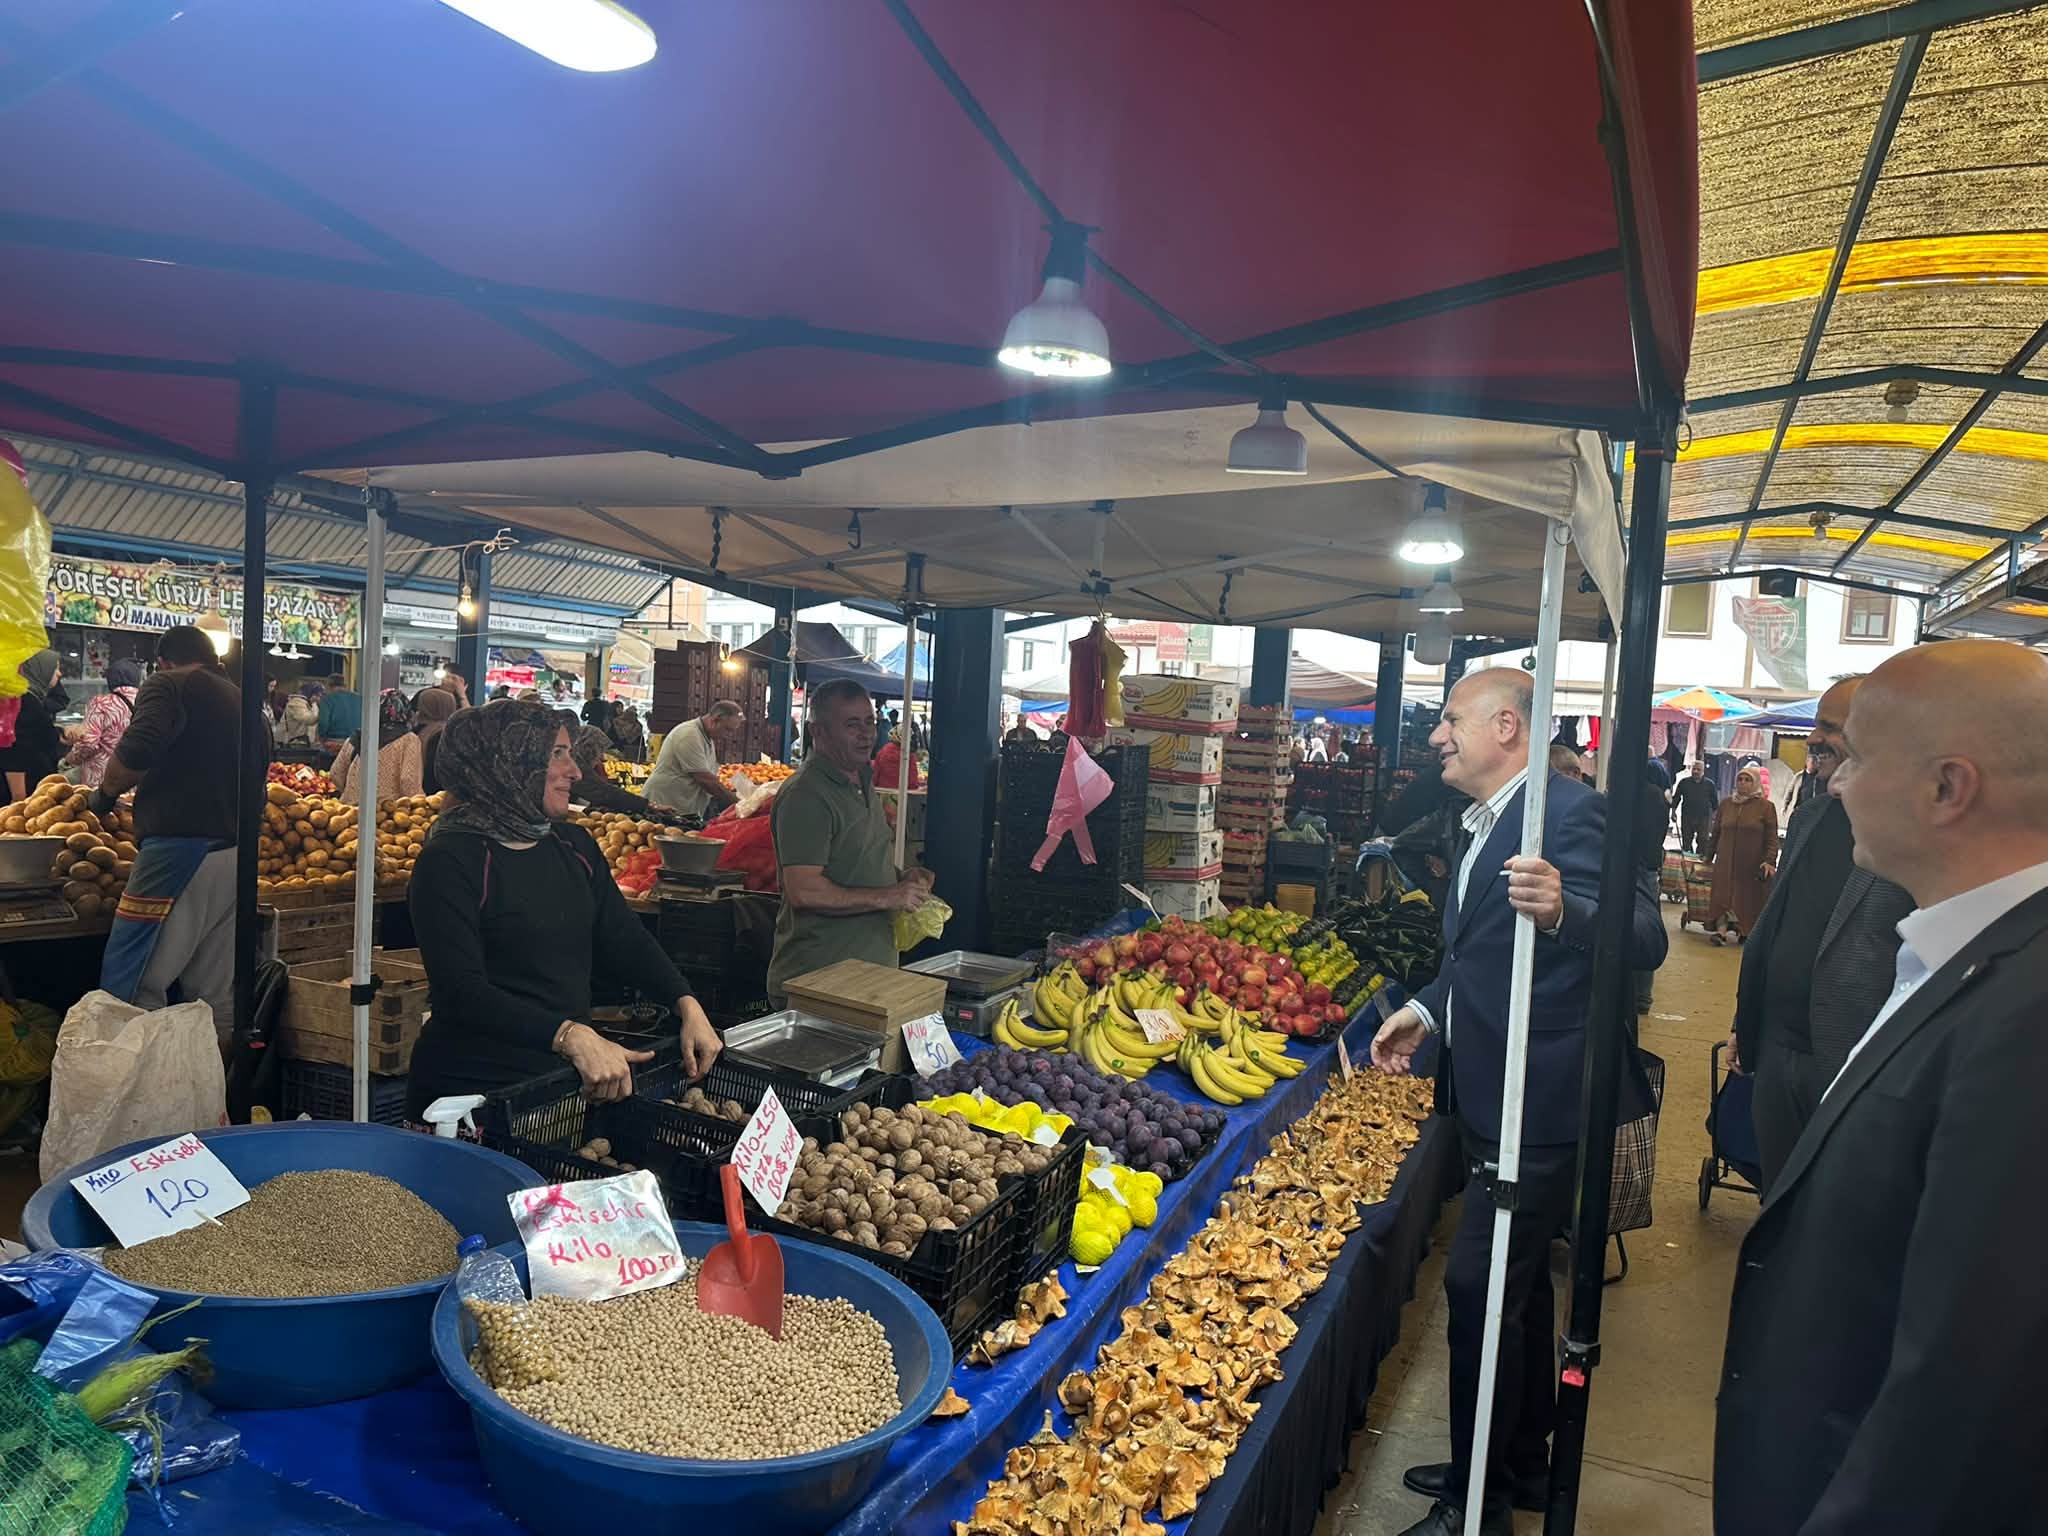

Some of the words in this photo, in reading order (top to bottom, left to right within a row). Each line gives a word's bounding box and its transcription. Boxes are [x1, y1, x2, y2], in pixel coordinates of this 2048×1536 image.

[268, 595, 338, 620] PAZARI
[924, 1040, 949, 1069] 50
[144, 1178, 210, 1219] 120
[548, 1234, 613, 1267] Kilo
